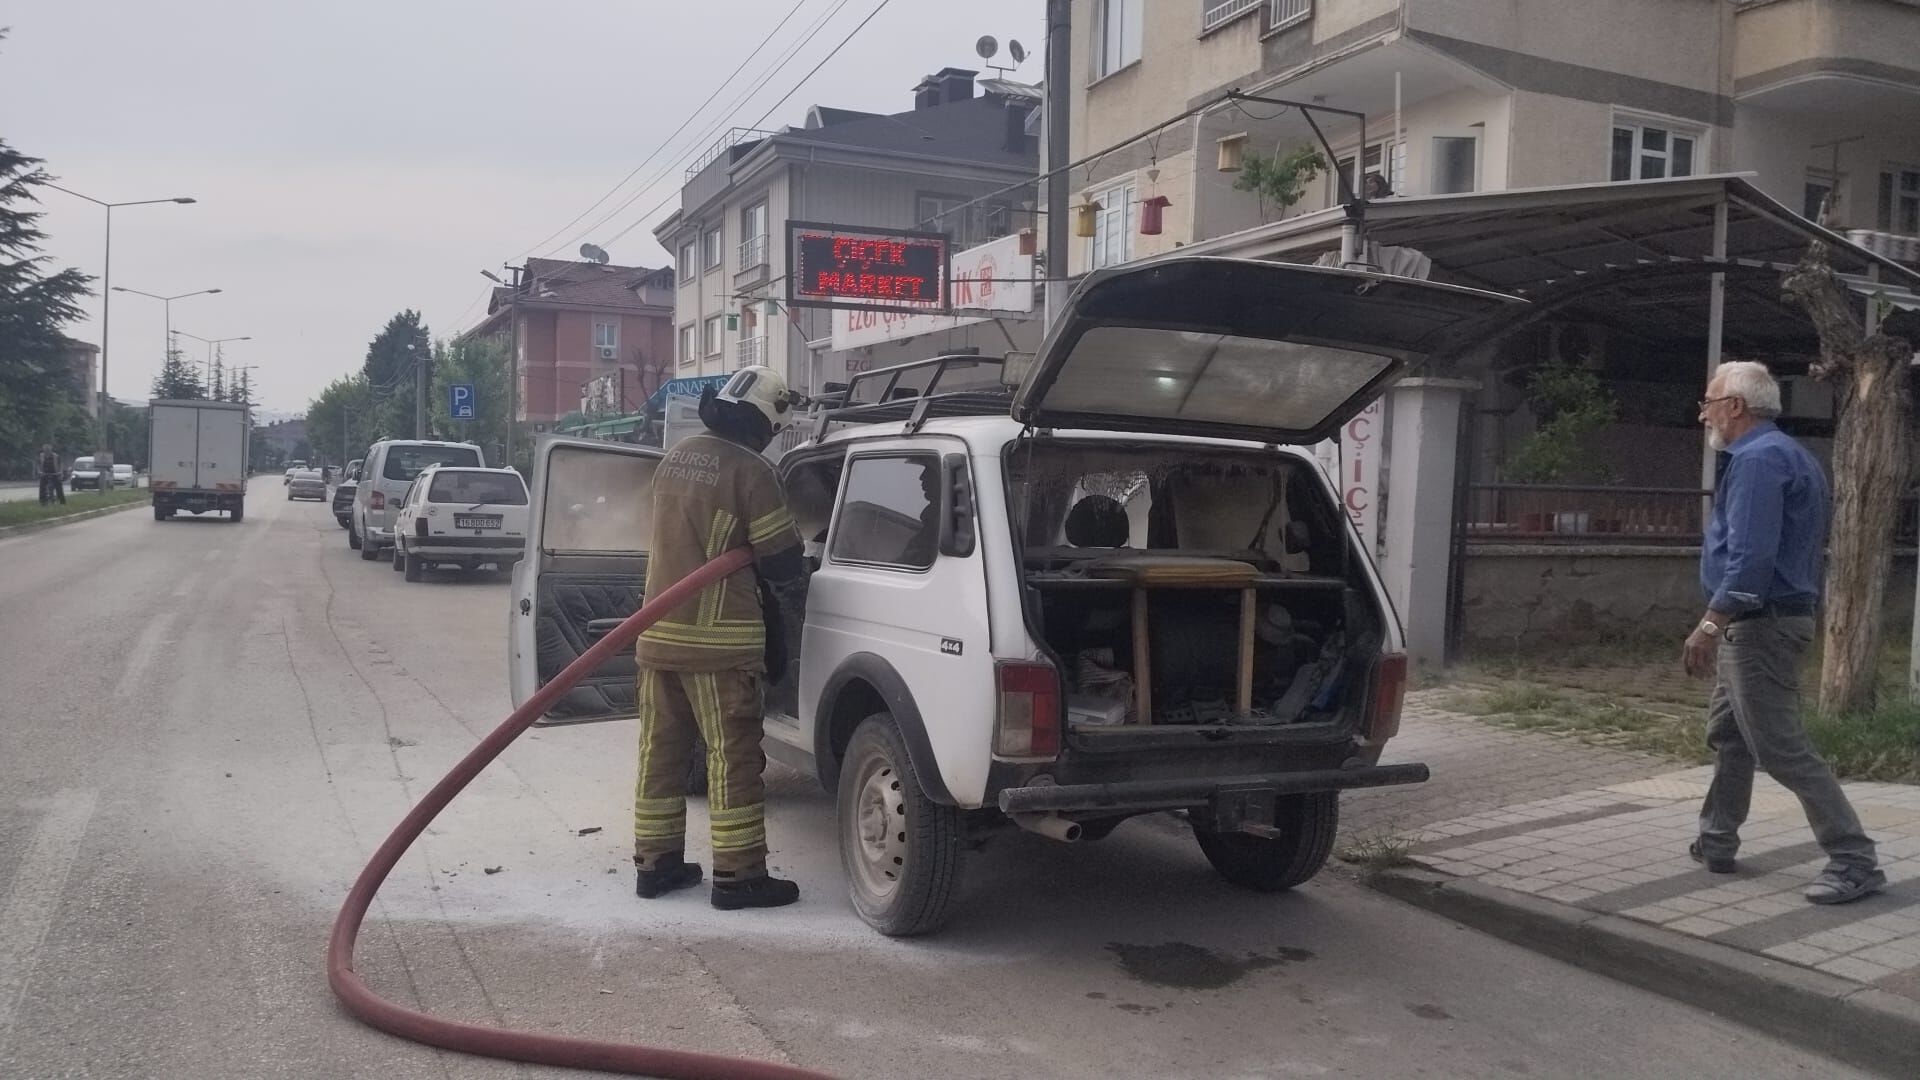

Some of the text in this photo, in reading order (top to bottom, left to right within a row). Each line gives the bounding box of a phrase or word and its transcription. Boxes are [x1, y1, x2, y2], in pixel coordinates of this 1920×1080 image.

[818, 271, 924, 297] MARKET
[454, 386, 468, 405] P
[670, 450, 720, 471] BURSA
[662, 463, 721, 487] İTFAİYESİ
